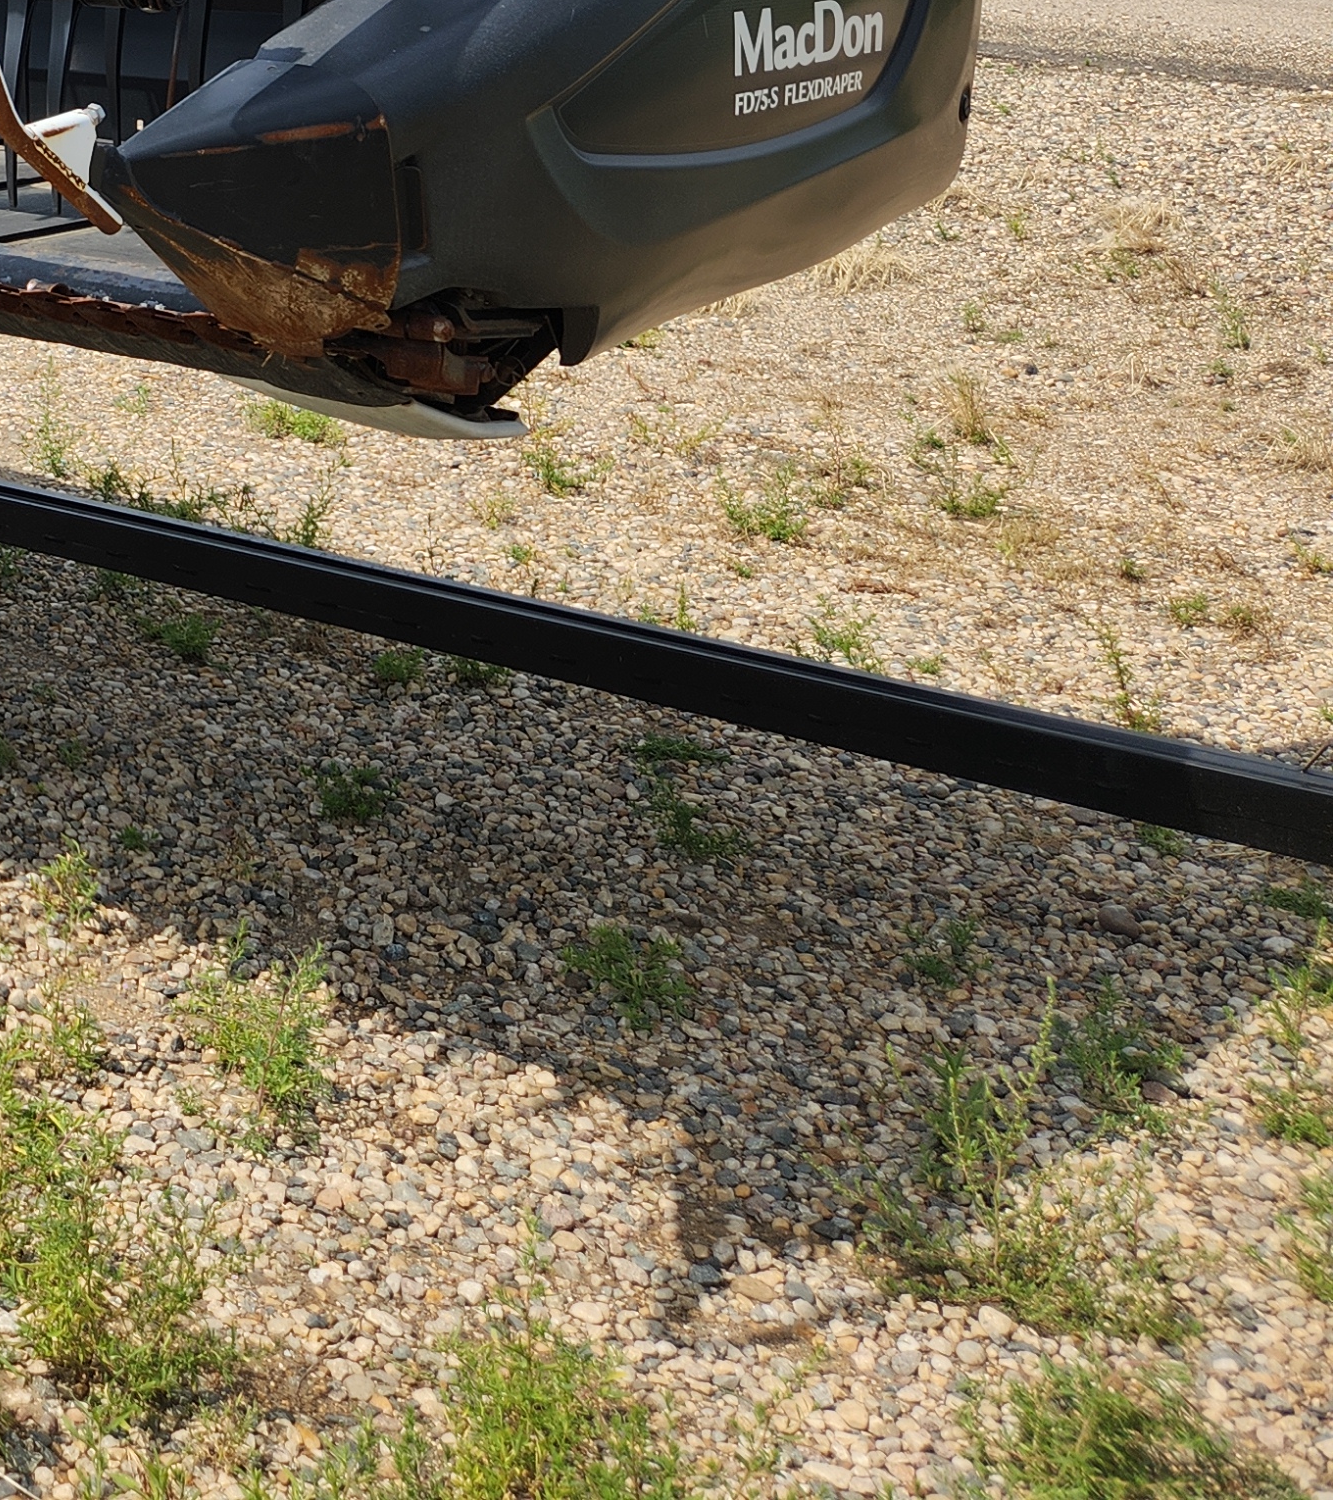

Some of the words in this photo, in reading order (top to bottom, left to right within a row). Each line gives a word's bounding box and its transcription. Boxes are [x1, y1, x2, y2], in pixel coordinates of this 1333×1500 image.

[733, 0, 883, 77] MacDon
[734, 86, 779, 116] FD75-S
[783, 70, 863, 106] FLEXDRAPER
